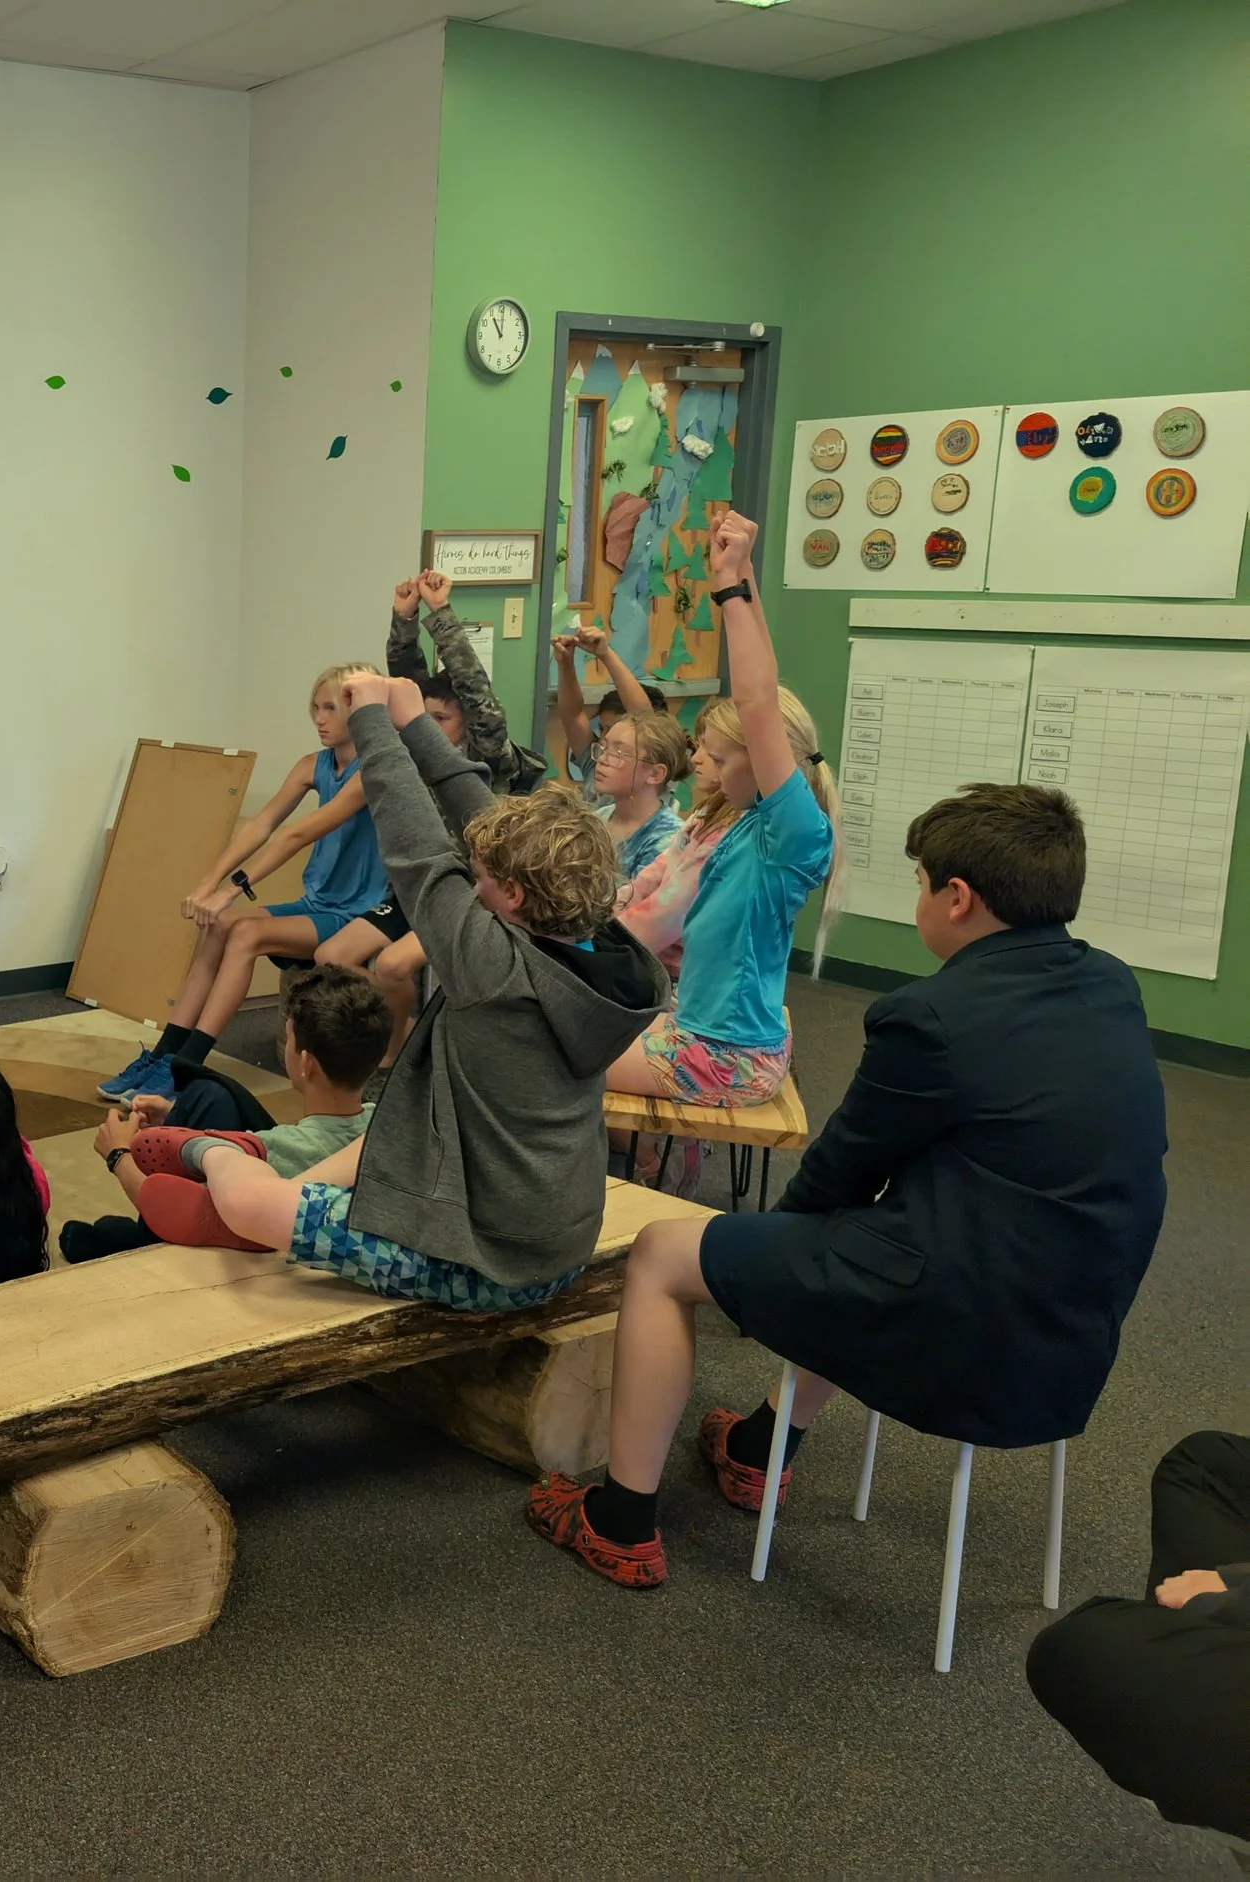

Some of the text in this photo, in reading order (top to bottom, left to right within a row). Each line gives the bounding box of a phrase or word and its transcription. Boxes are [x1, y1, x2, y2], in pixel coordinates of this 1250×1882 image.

[482, 319, 488, 327] 10
[515, 318, 520, 326] 2
[478, 332, 482, 340] 9
[480, 345, 485, 353] 8
[468, 542, 480, 559] do
[483, 541, 502, 559] hard
[468, 566, 488, 574] ACADEMY
[489, 566, 511, 574] COLUMBUS
[1043, 699, 1069, 710] Joseph
[1038, 768, 1056, 778] Noah
